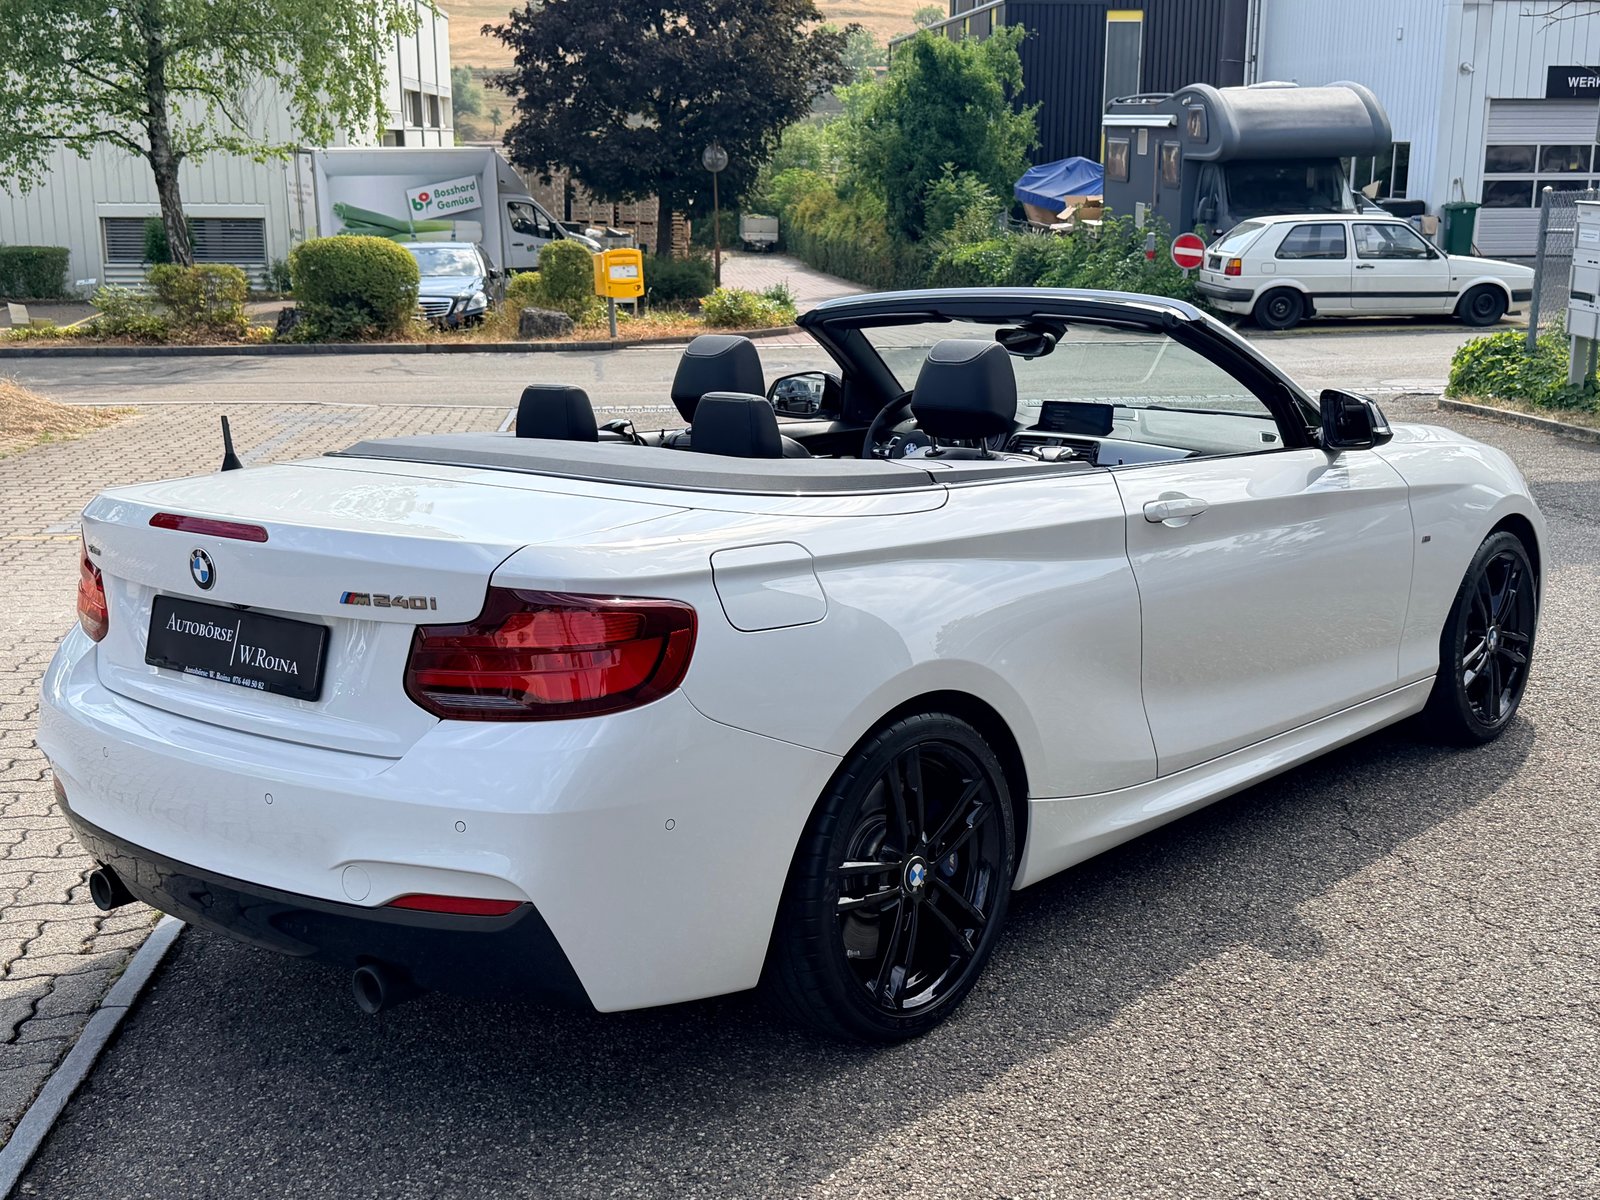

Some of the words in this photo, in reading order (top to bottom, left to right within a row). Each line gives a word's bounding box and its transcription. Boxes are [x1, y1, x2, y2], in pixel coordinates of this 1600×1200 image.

[433, 181, 476, 198] Bosshard
[437, 196, 475, 210] Gemüse
[166, 612, 234, 643] AUTOBÖRSE
[184, 665, 209, 677] Autobörse
[209, 670, 216, 679] W.
[216, 672, 231, 682] Roina
[232, 675, 241, 685] 076
[251, 679, 258, 688] 50
